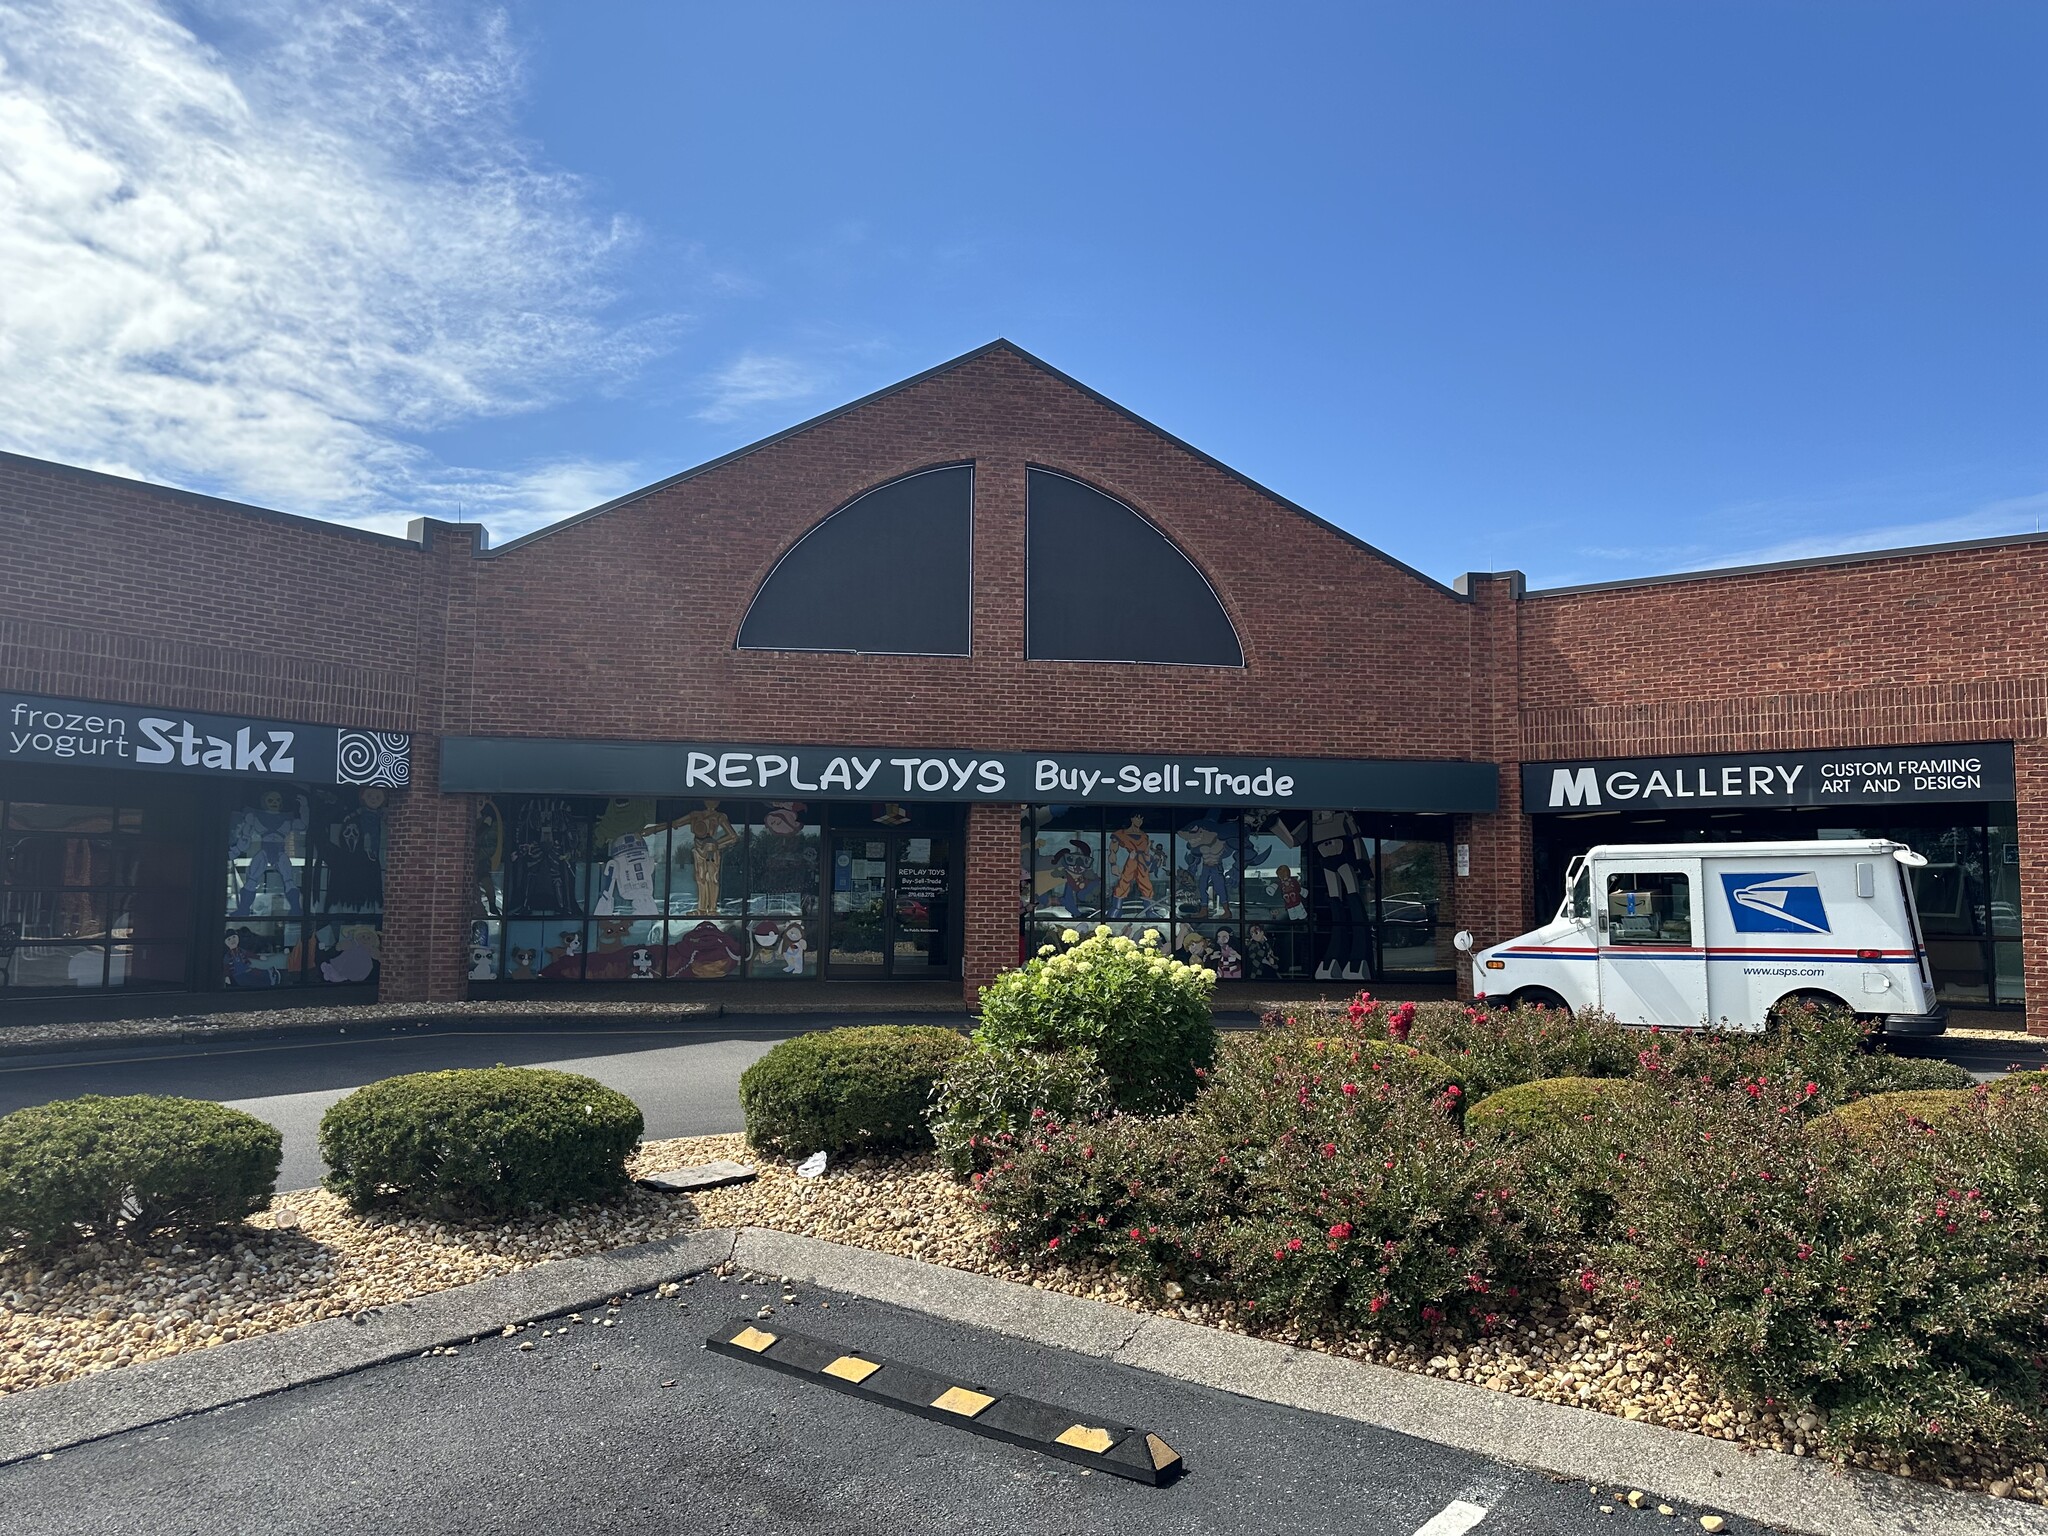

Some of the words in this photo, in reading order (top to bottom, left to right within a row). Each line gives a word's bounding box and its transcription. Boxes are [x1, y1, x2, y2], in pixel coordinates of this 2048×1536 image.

[10, 702, 126, 736] frozen
[9, 731, 129, 758] yogurt
[685, 751, 882, 791] REPLAY
[889, 758, 1006, 794] TOYS
[1035, 759, 1294, 797] Buy-Sell-Trade
[1820, 761, 1893, 778] CUSTOM
[1898, 758, 1982, 775] FRAMING
[1548, 767, 1602, 807] M
[1605, 765, 1804, 800] GALLERY
[1820, 779, 1851, 794] ART
[1862, 778, 1901, 793] AND
[1914, 774, 1982, 791] DESIGN
[898, 868, 927, 876] REPLAY
[1743, 967, 1825, 978] www.usps.com
